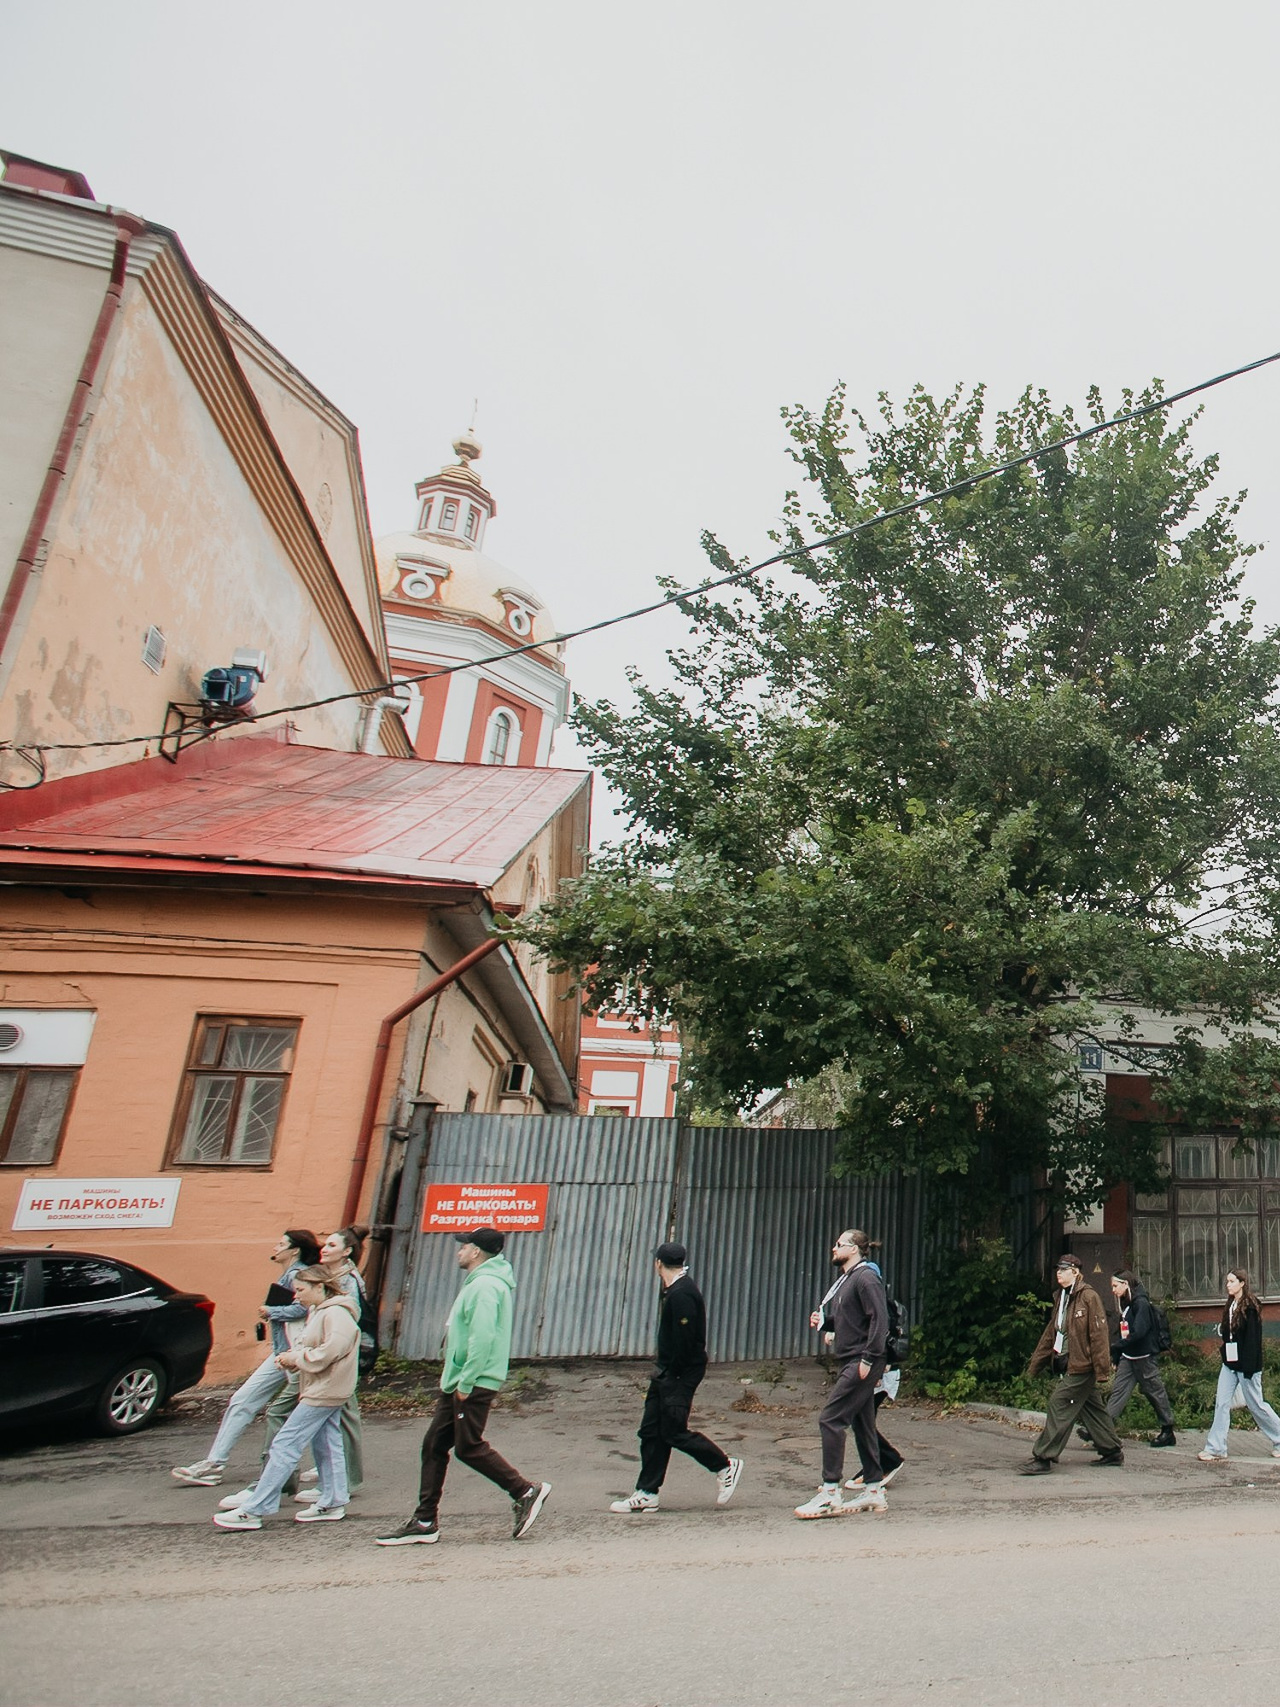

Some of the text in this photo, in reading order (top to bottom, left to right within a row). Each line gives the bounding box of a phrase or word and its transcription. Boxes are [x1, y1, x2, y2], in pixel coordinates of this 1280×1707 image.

[461, 1187, 517, 1197] Машины
[30, 1198, 166, 1211] НЕ ПАРКОВАТЬ!
[437, 1200, 537, 1211] НЕ ПАРКОВАТЬ!
[117, 1212, 144, 1220] СНЕГА!
[429, 1214, 540, 1226] Разгрузка товара
